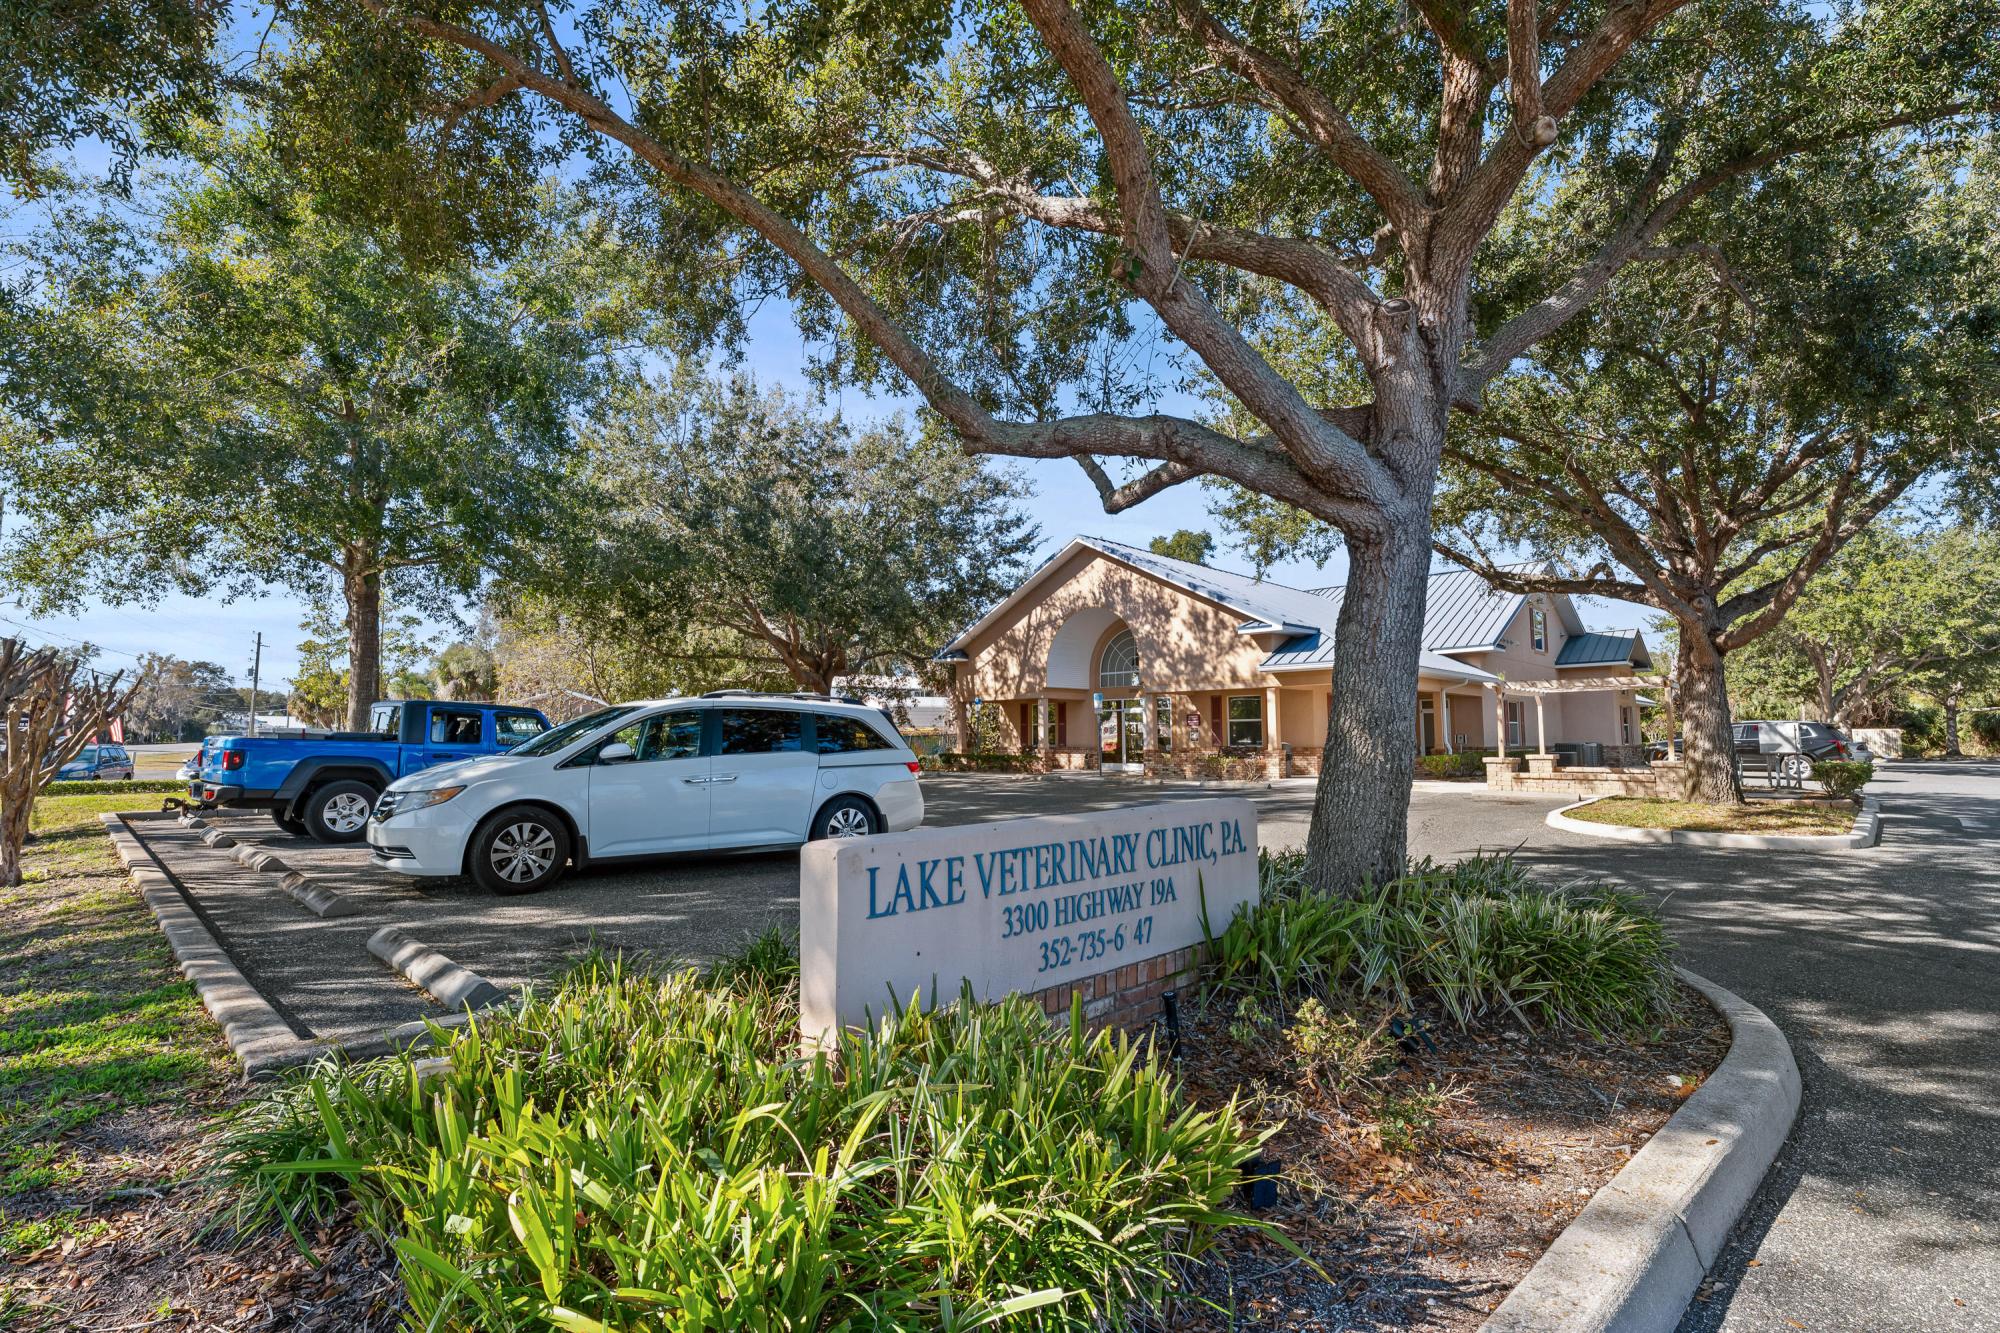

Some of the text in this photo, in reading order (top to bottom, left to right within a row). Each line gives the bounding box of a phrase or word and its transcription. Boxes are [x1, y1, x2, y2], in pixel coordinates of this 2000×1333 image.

[865, 818, 1247, 920] LAKE VETERINARY CLINIC, P.A.
[1002, 876, 1178, 939] 3300 HIGHWAY 19A
[1038, 915, 1153, 973] 352-735-647
